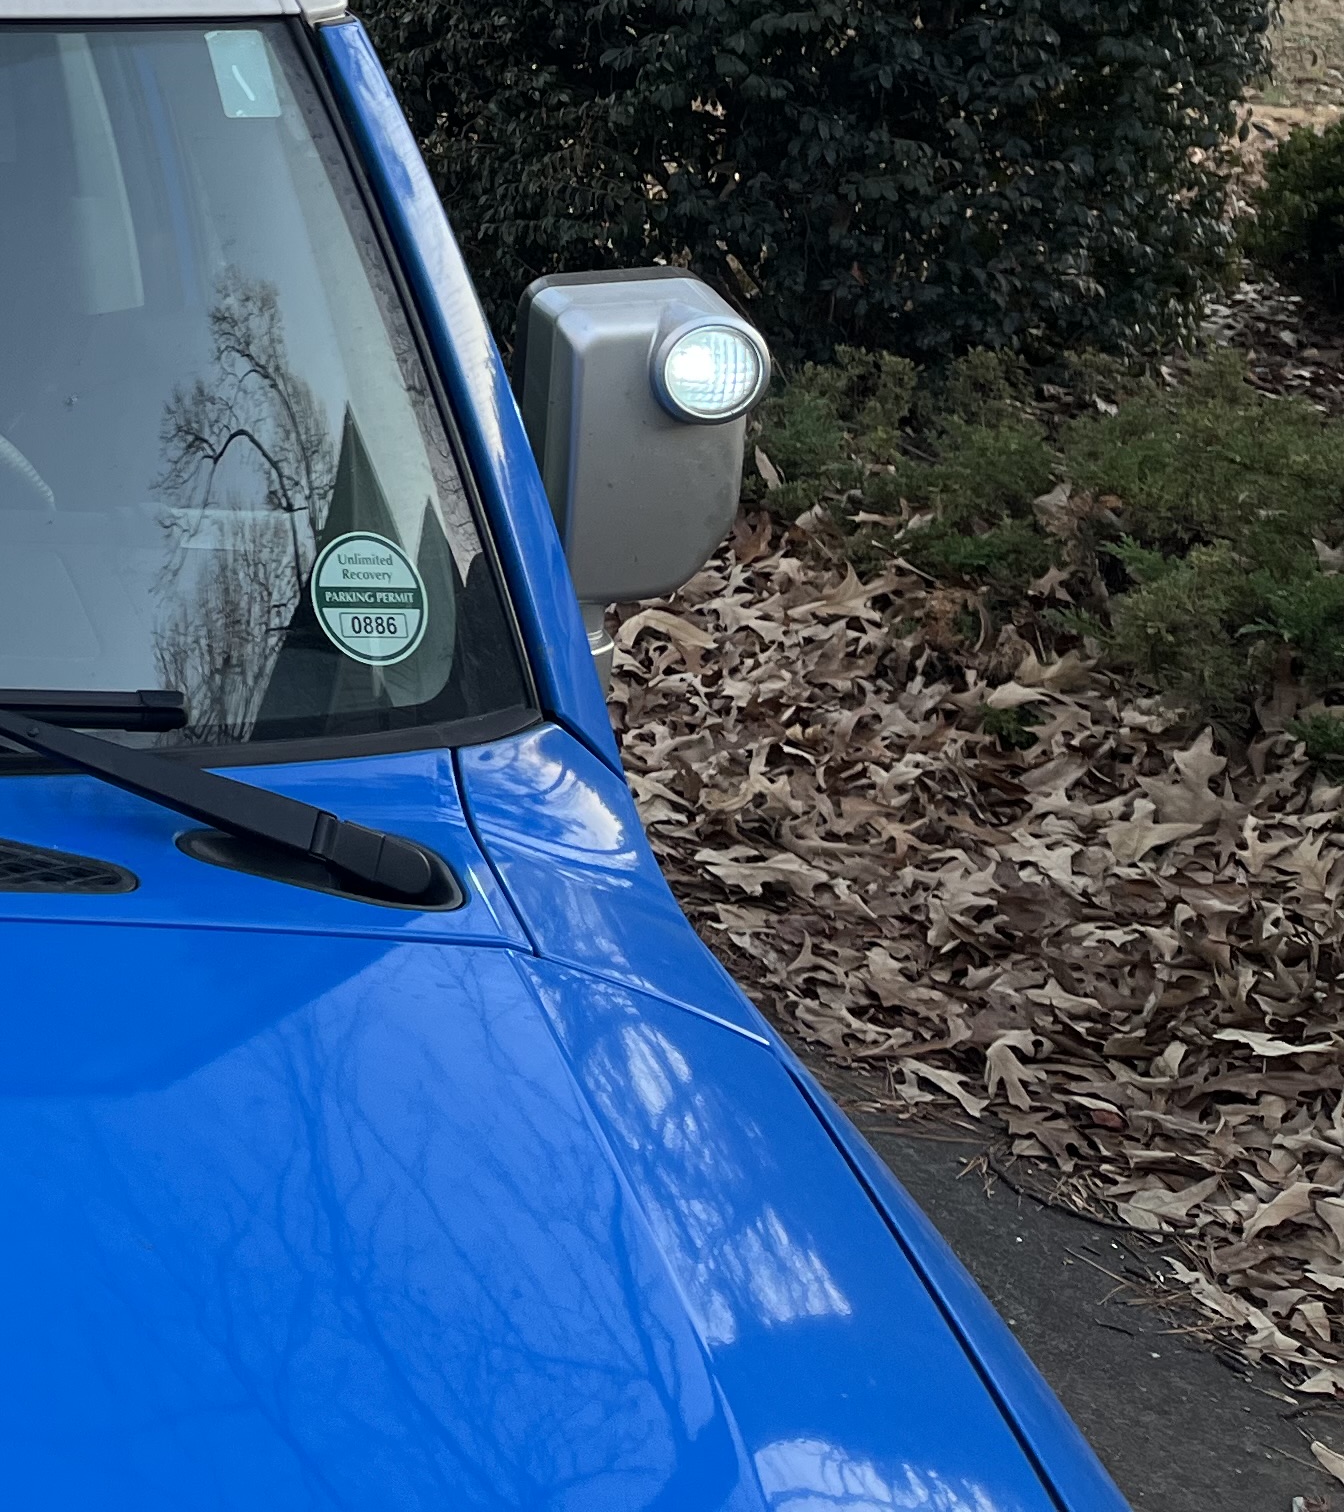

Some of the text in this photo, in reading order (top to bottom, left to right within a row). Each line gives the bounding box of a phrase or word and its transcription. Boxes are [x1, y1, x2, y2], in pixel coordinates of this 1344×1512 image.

[337, 554, 393, 566] Unlimited
[342, 569, 392, 582] Recovery
[325, 591, 414, 604] PARKING PERMIT
[351, 616, 397, 635] 0886
